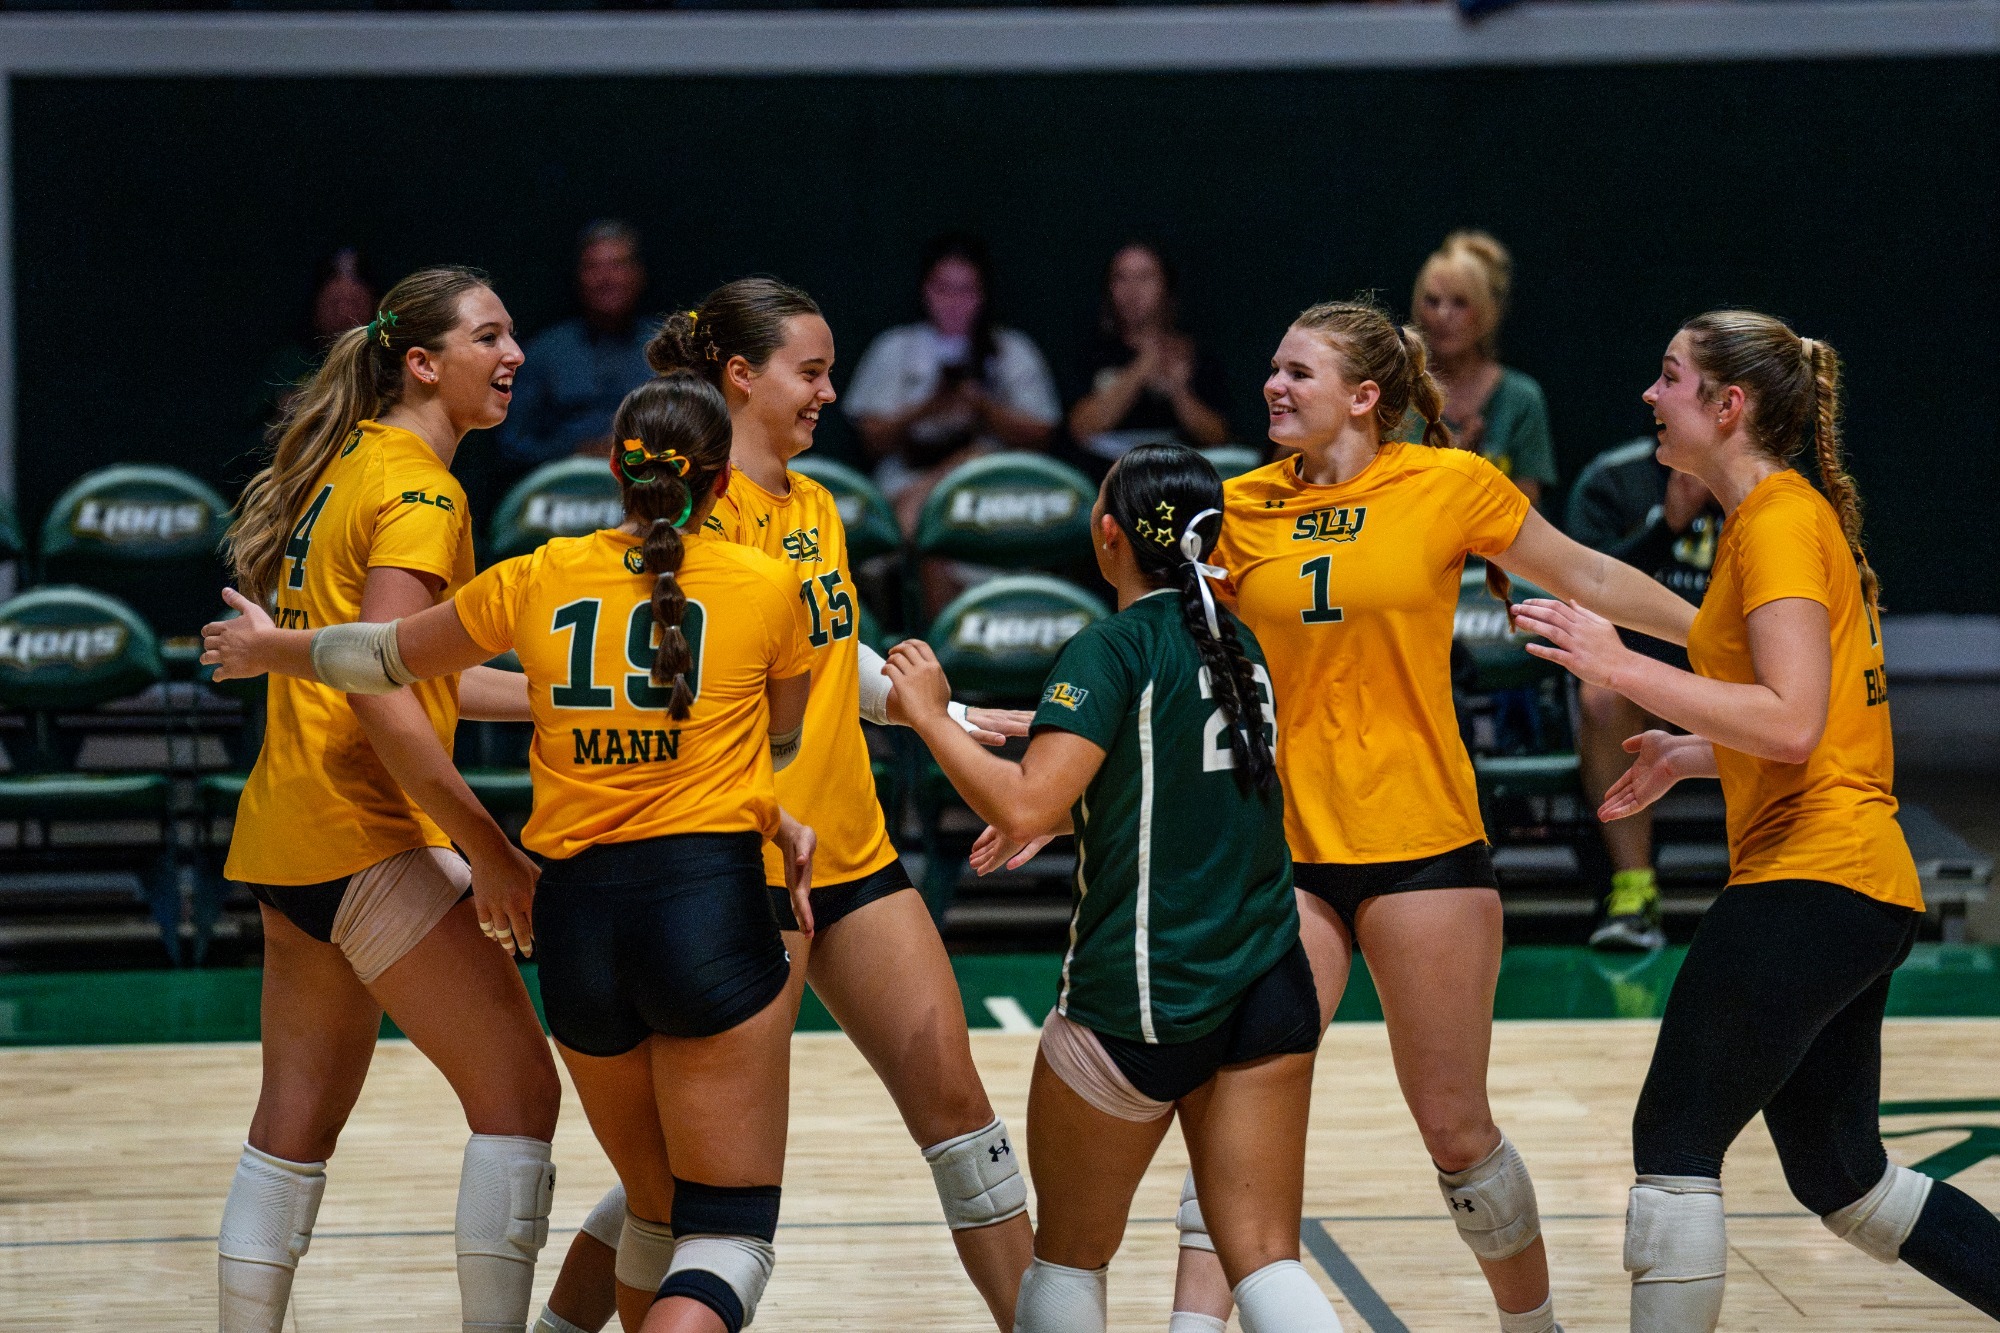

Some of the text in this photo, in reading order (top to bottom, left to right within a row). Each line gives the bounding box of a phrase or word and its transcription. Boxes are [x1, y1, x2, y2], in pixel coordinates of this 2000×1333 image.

[284, 483, 335, 591] 4
[526, 496, 625, 532] Lion
[1292, 506, 1367, 543] SLU
[799, 568, 855, 649] 15
[1299, 554, 1344, 625] 1
[550, 597, 707, 711] 19
[1041, 682, 1089, 711] SLU
[572, 728, 682, 765] MANN
